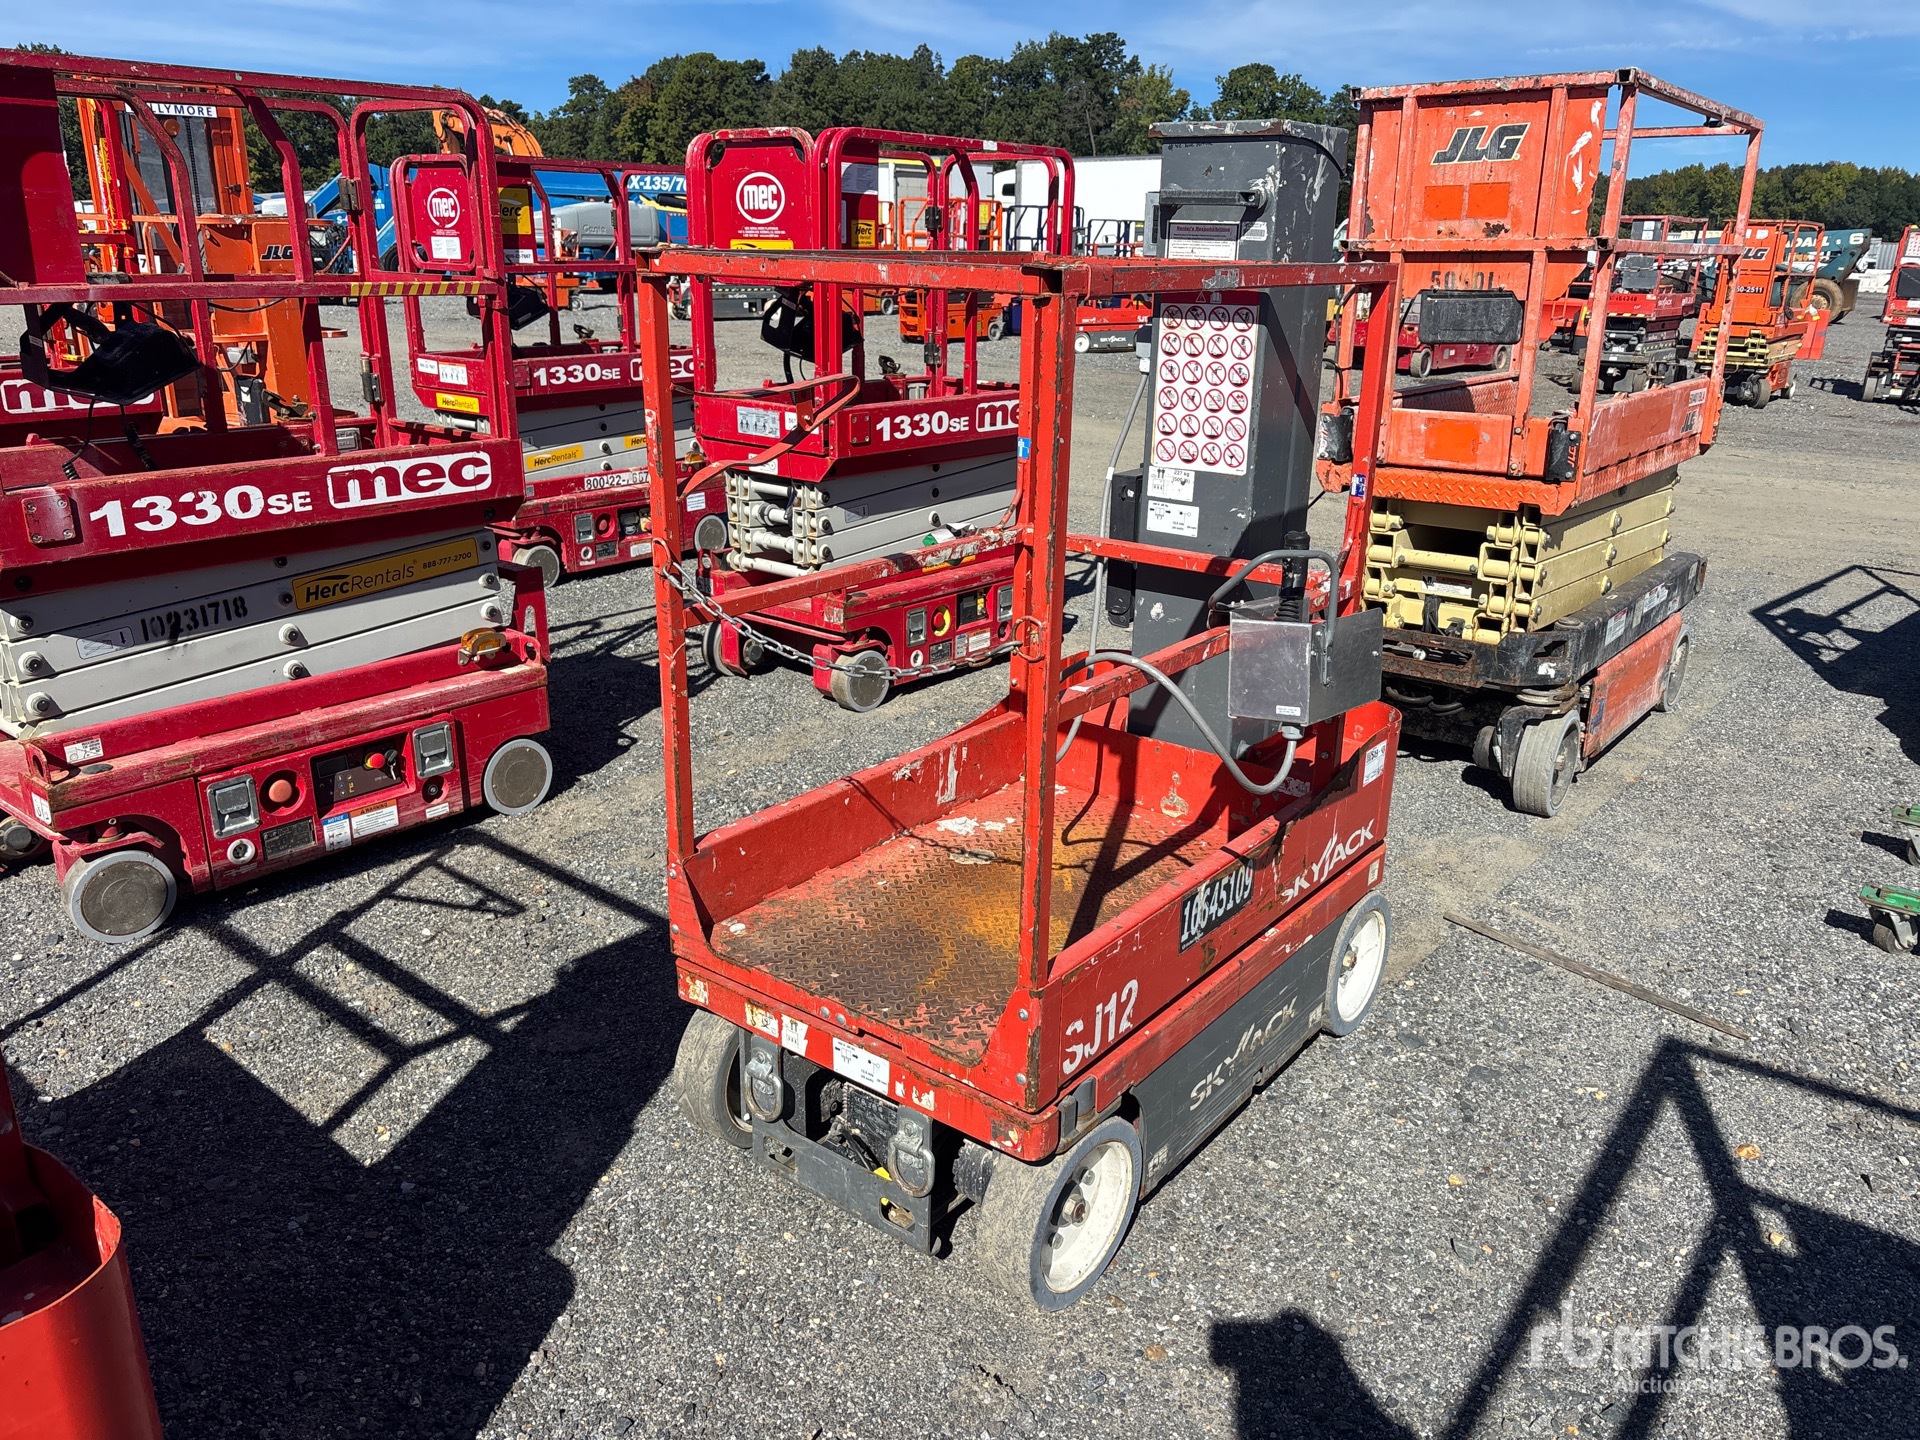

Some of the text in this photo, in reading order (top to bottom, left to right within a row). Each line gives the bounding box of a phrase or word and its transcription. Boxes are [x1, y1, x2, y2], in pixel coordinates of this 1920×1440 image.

[1431, 122, 1531, 166] JLG
[431, 197, 456, 218] mec
[743, 185, 778, 211] mec
[500, 204, 522, 217] erc
[1849, 232, 1864, 245] 6
[1099, 335, 1127, 343] SKYJACK
[533, 363, 622, 387] 1330SE
[875, 410, 970, 442] 1330SE
[533, 450, 580, 467] HercRentals
[89, 455, 492, 538] 1330SE mec
[327, 815, 344, 824] NOTICE
[1281, 818, 1375, 906] SKYJACK
[1062, 979, 1140, 1075] SJ12
